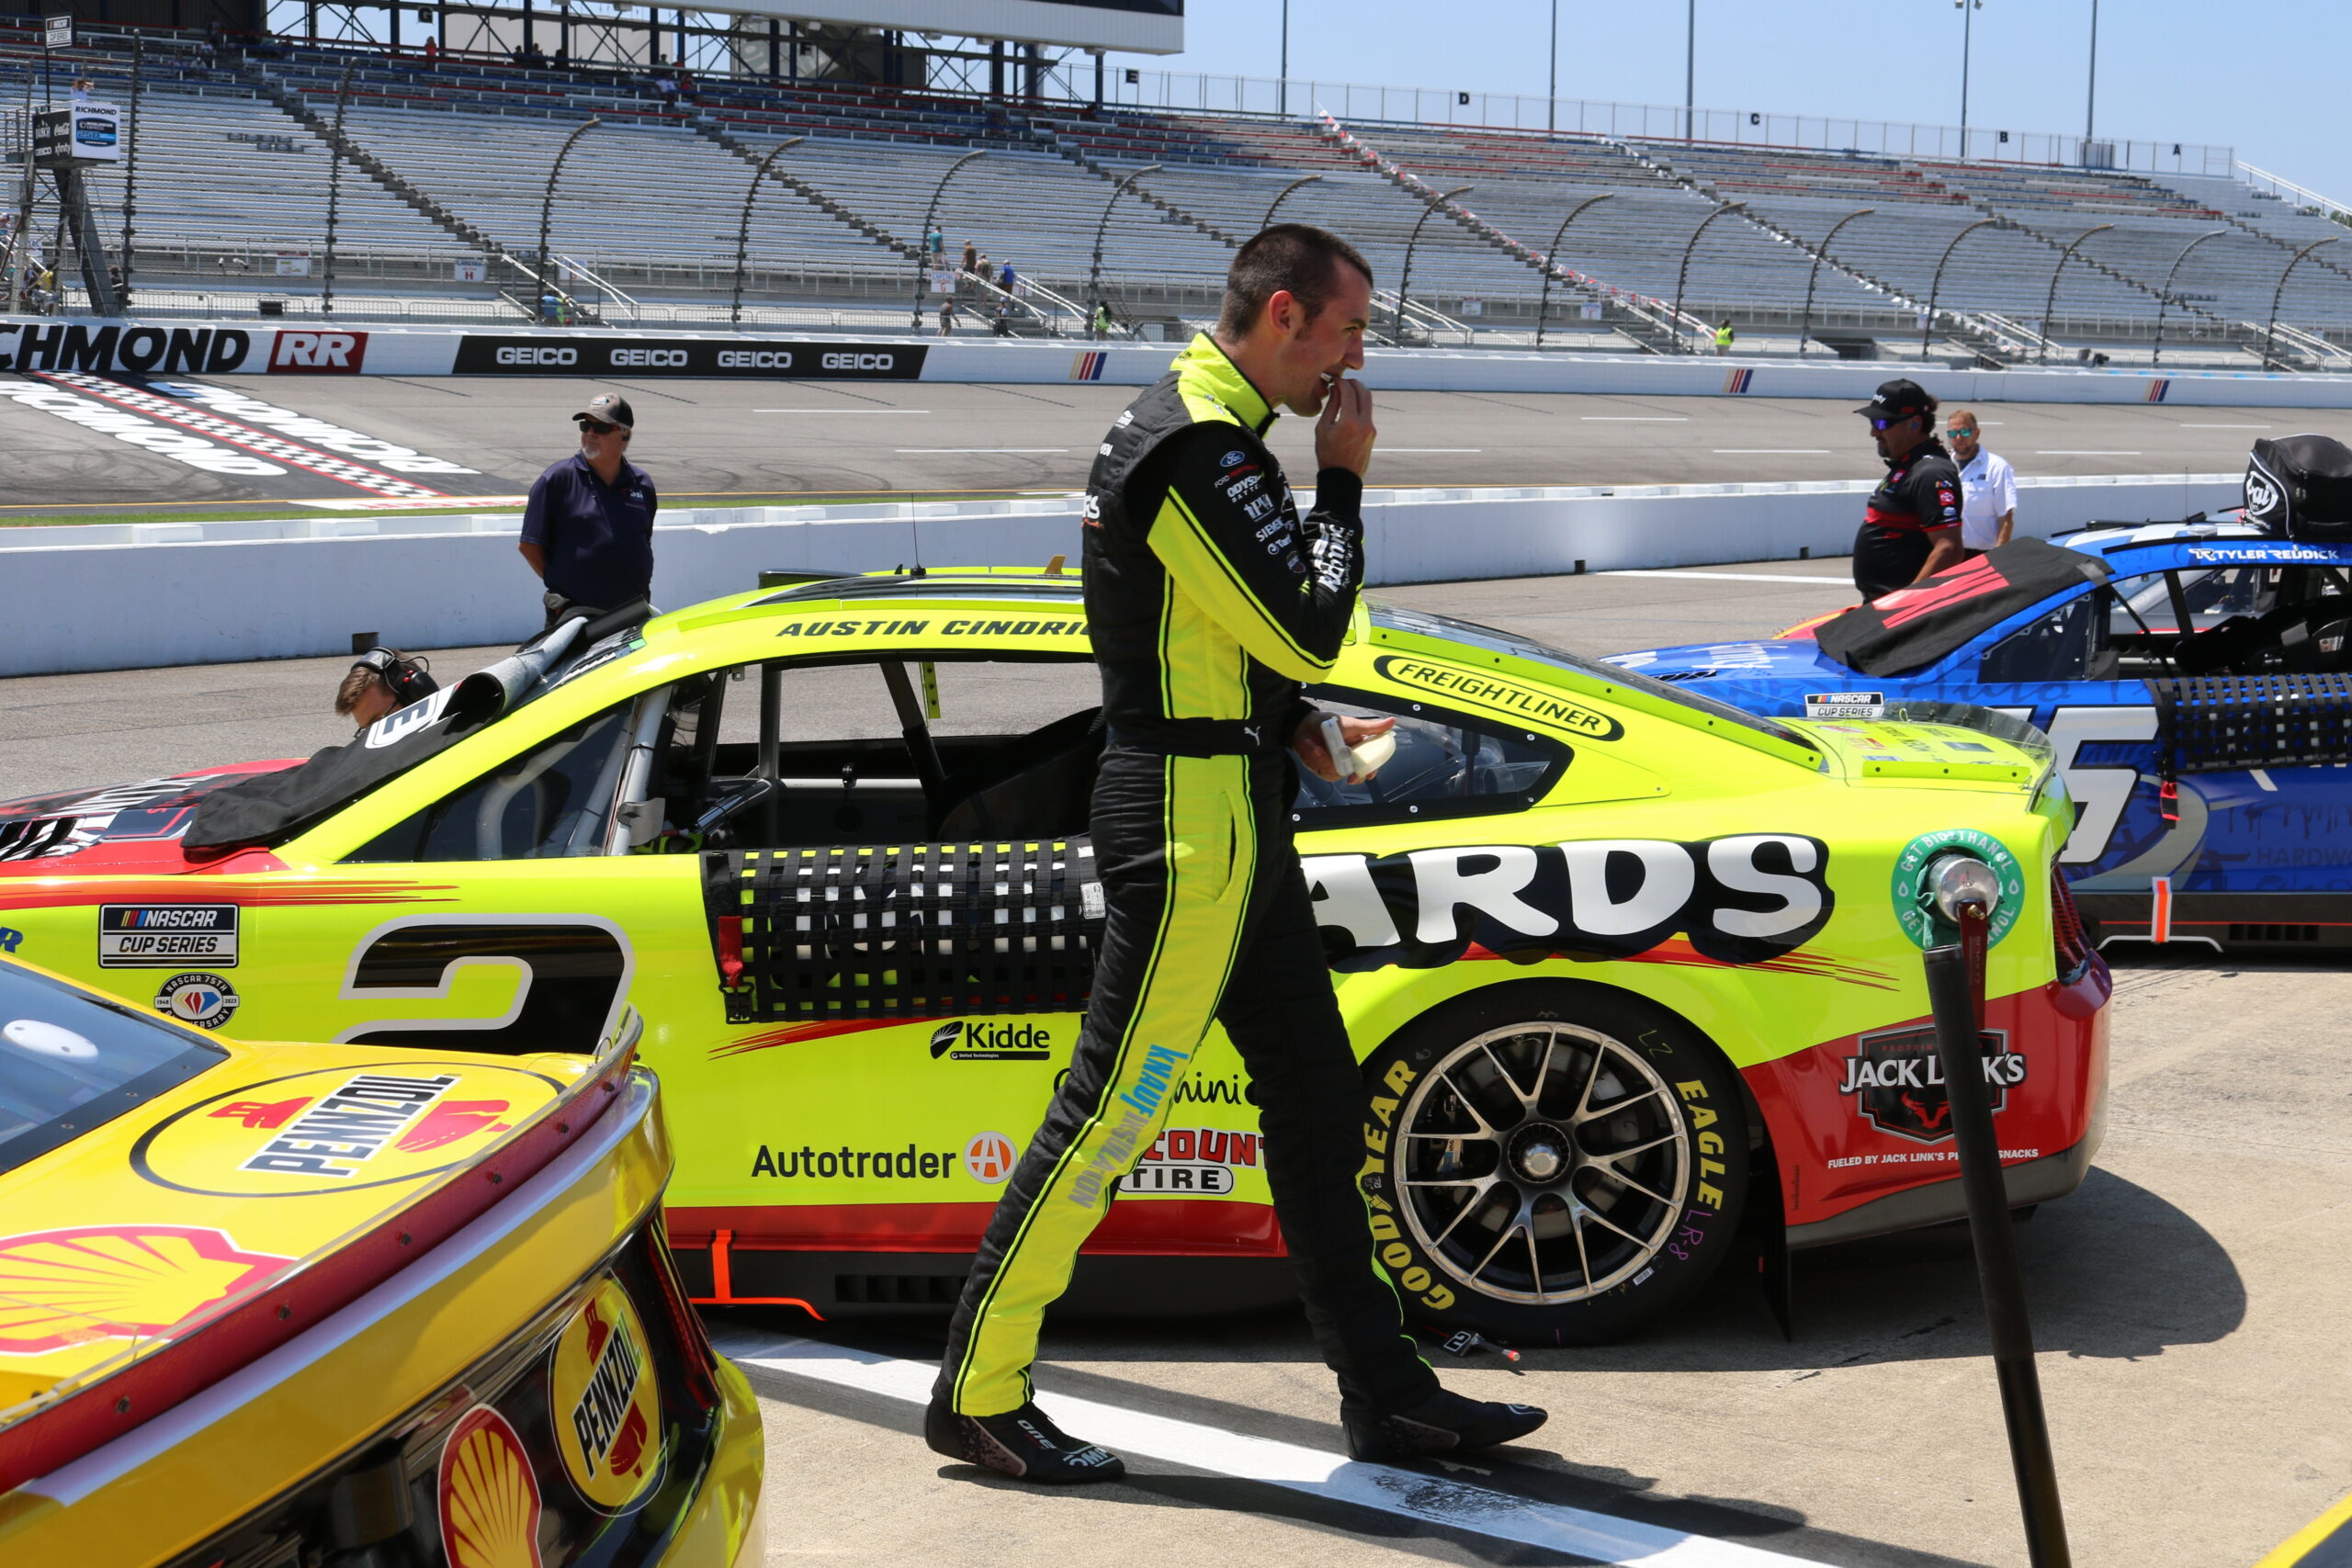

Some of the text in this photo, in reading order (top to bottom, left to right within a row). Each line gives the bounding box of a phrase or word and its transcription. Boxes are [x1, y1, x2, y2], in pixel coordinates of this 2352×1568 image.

[1125, 70, 1139, 84] E
[1459, 92, 1469, 105] D
[75, 107, 117, 116] RICHMOND
[1750, 113, 1760, 125] C
[1999, 131, 2008, 142] B
[2173, 145, 2181, 155] A
[0, 323, 356, 372] CHMOND RR
[496, 346, 894, 370] GEICO GEICO GEICO GEICO
[2214, 549, 2267, 560] TYLER
[2267, 549, 2339, 560] REDDICK
[775, 620, 929, 637] AUSTIN
[1397, 663, 1601, 731] FREIGHTLINER
[1830, 694, 1871, 704] NASCAR
[1817, 707, 1873, 716] CUP SERIES
[1300, 835, 1822, 947] ARDS
[144, 910, 218, 927] NASCAR
[119, 936, 218, 953] CUP SERIES
[165, 975, 228, 992] NASCAR 75TH
[967, 1022, 1050, 1048] Kidde
[1882, 1043, 1933, 1052] PROTEIN
[1119, 1043, 1190, 1119] KNAUF
[1839, 1053, 2025, 1092] JACK LK'S
[239, 1075, 458, 1177] PENNZOIL
[1675, 1079, 1726, 1211] EAGLE
[752, 1144, 956, 1179] Autotrader
[1827, 1156, 1862, 1168] FUELED
[1864, 1155, 1878, 1165] BY
[1881, 1153, 1907, 1163] JACK
[1910, 1152, 1945, 1162] LINK'S
[1998, 1148, 2039, 1158] SNACKS
[1132, 1168, 1220, 1190] TIRE
[571, 1310, 642, 1482] PENNZOIL
